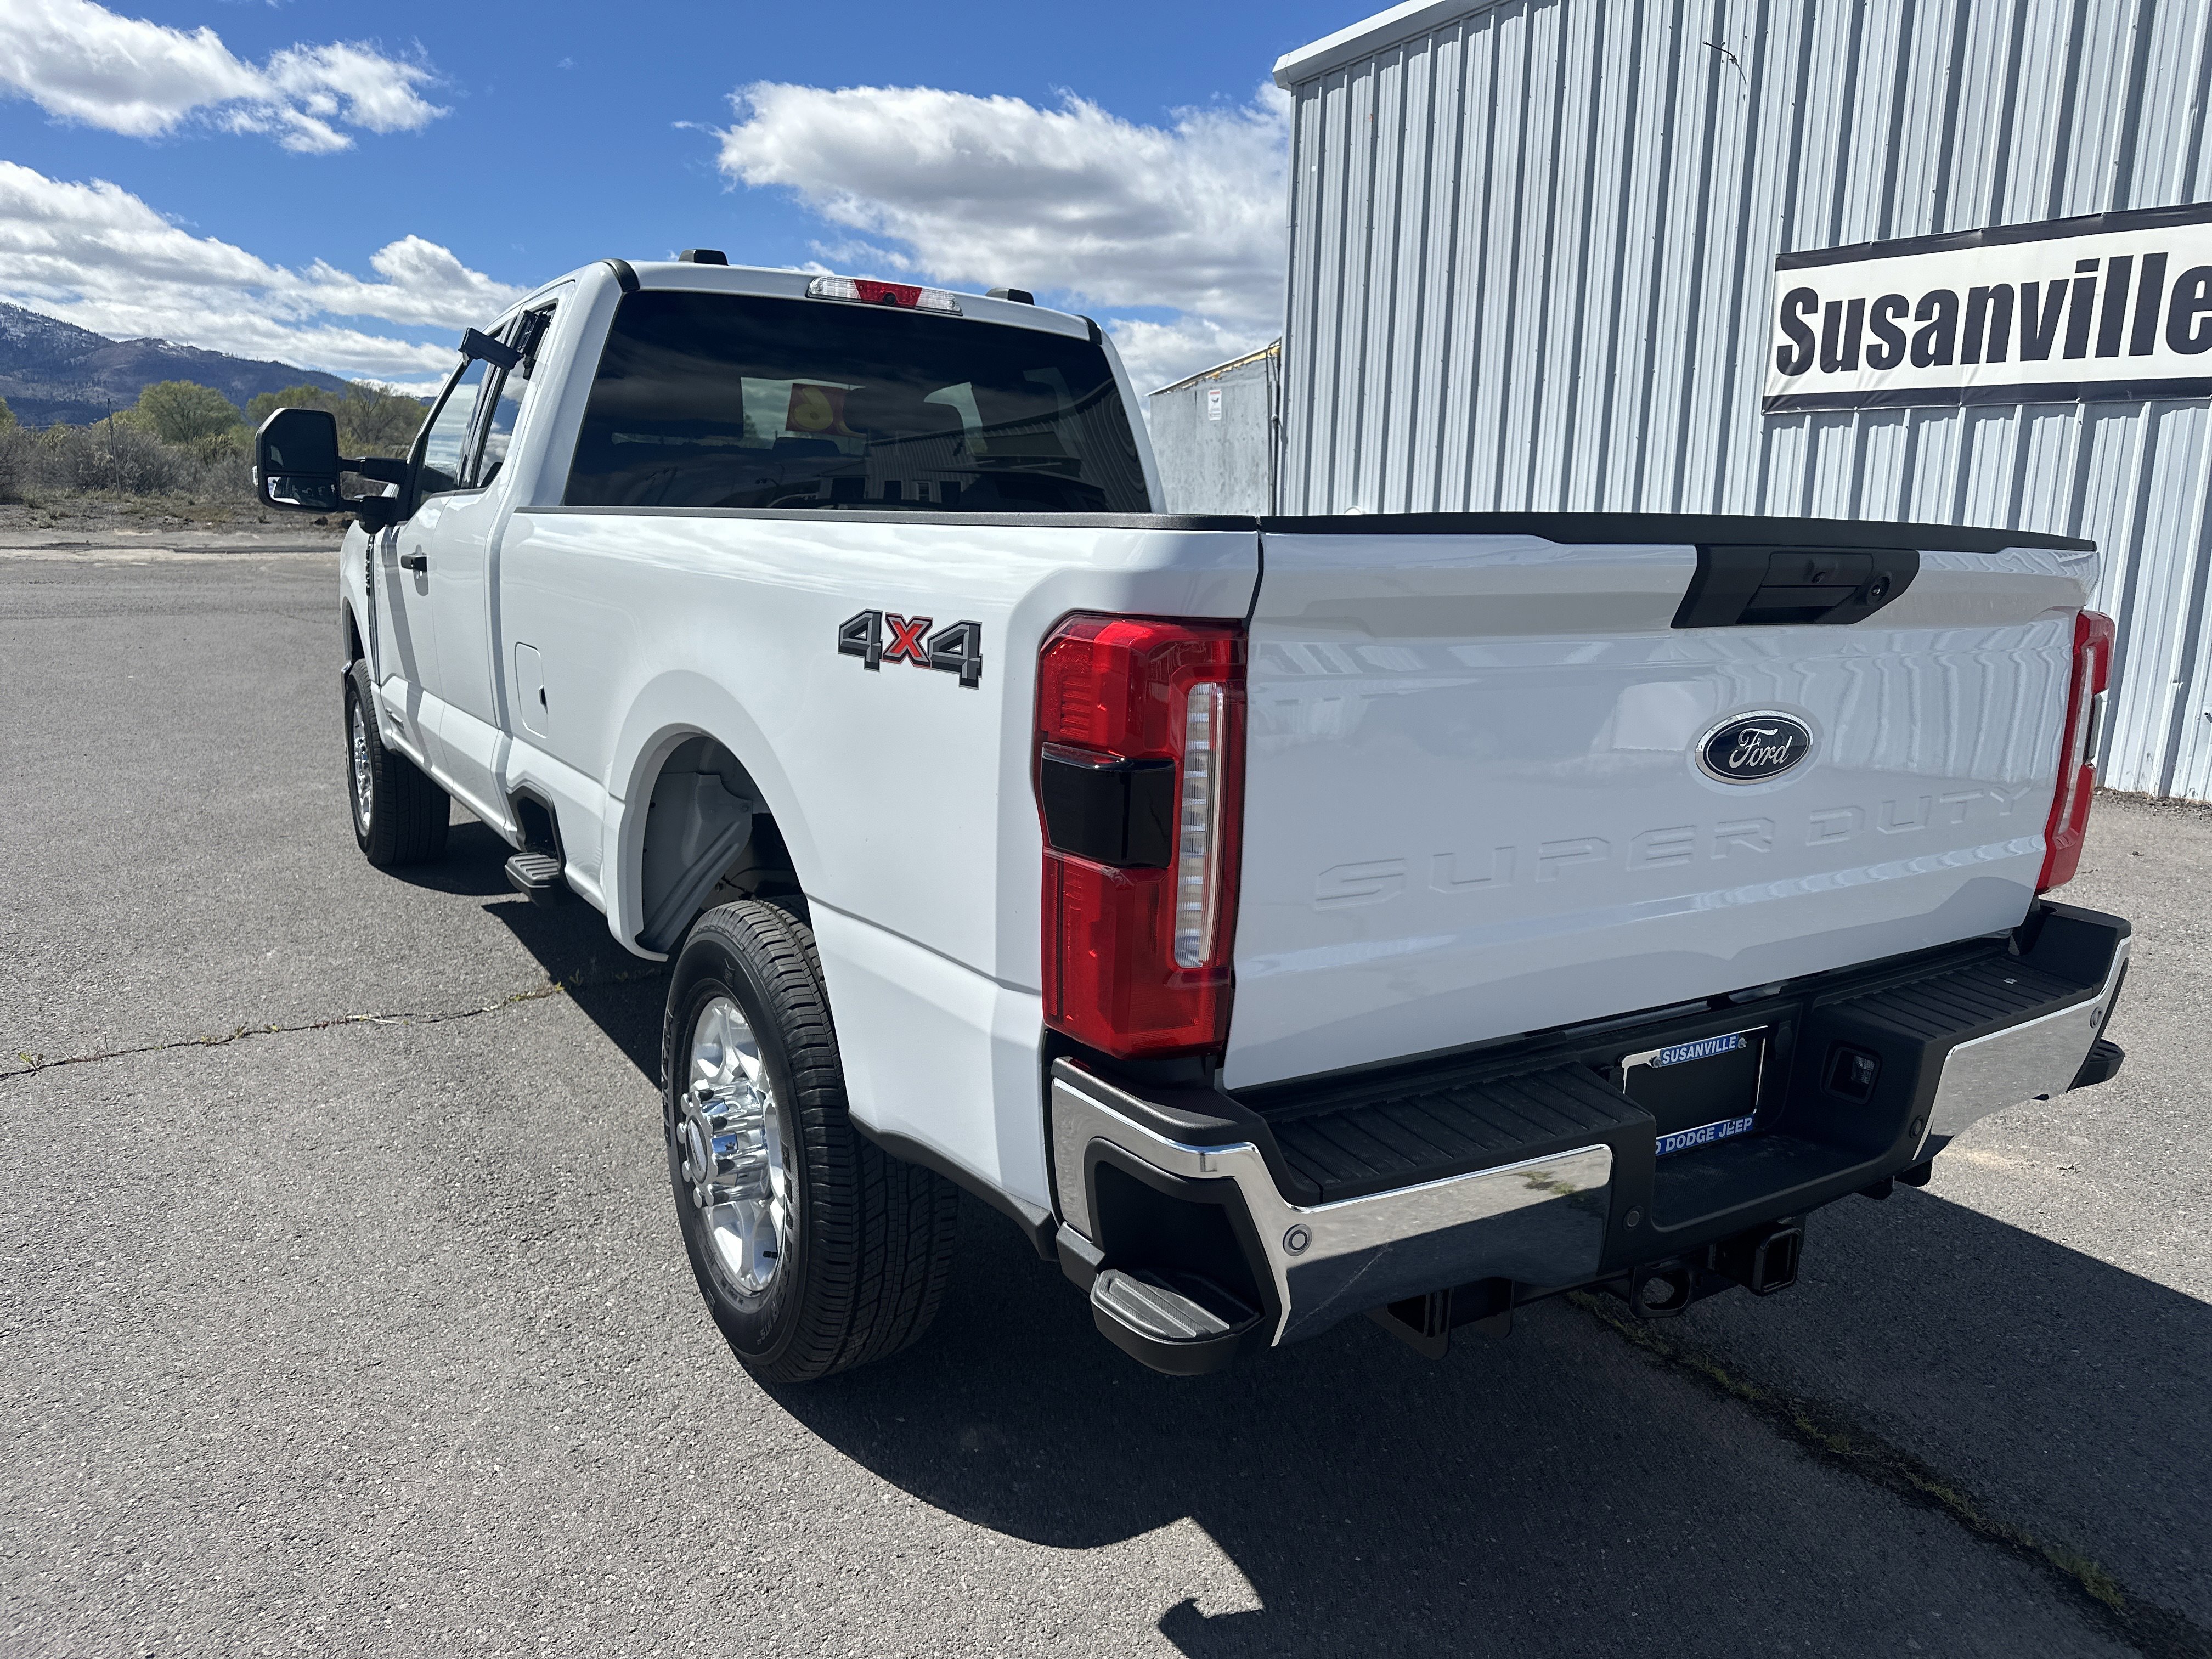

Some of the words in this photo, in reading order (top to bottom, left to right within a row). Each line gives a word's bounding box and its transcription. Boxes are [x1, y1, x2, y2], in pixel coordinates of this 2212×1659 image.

[1776, 252, 2212, 377] Susanville
[1729, 727, 1792, 768] Ford
[1313, 817, 1775, 911] SUPER
[1806, 786, 2030, 846] DUTY
[1662, 1036, 1736, 1064] SUSANVILLE
[1666, 1127, 1714, 1152] DODGE
[1719, 1117, 1753, 1138] JEEP
